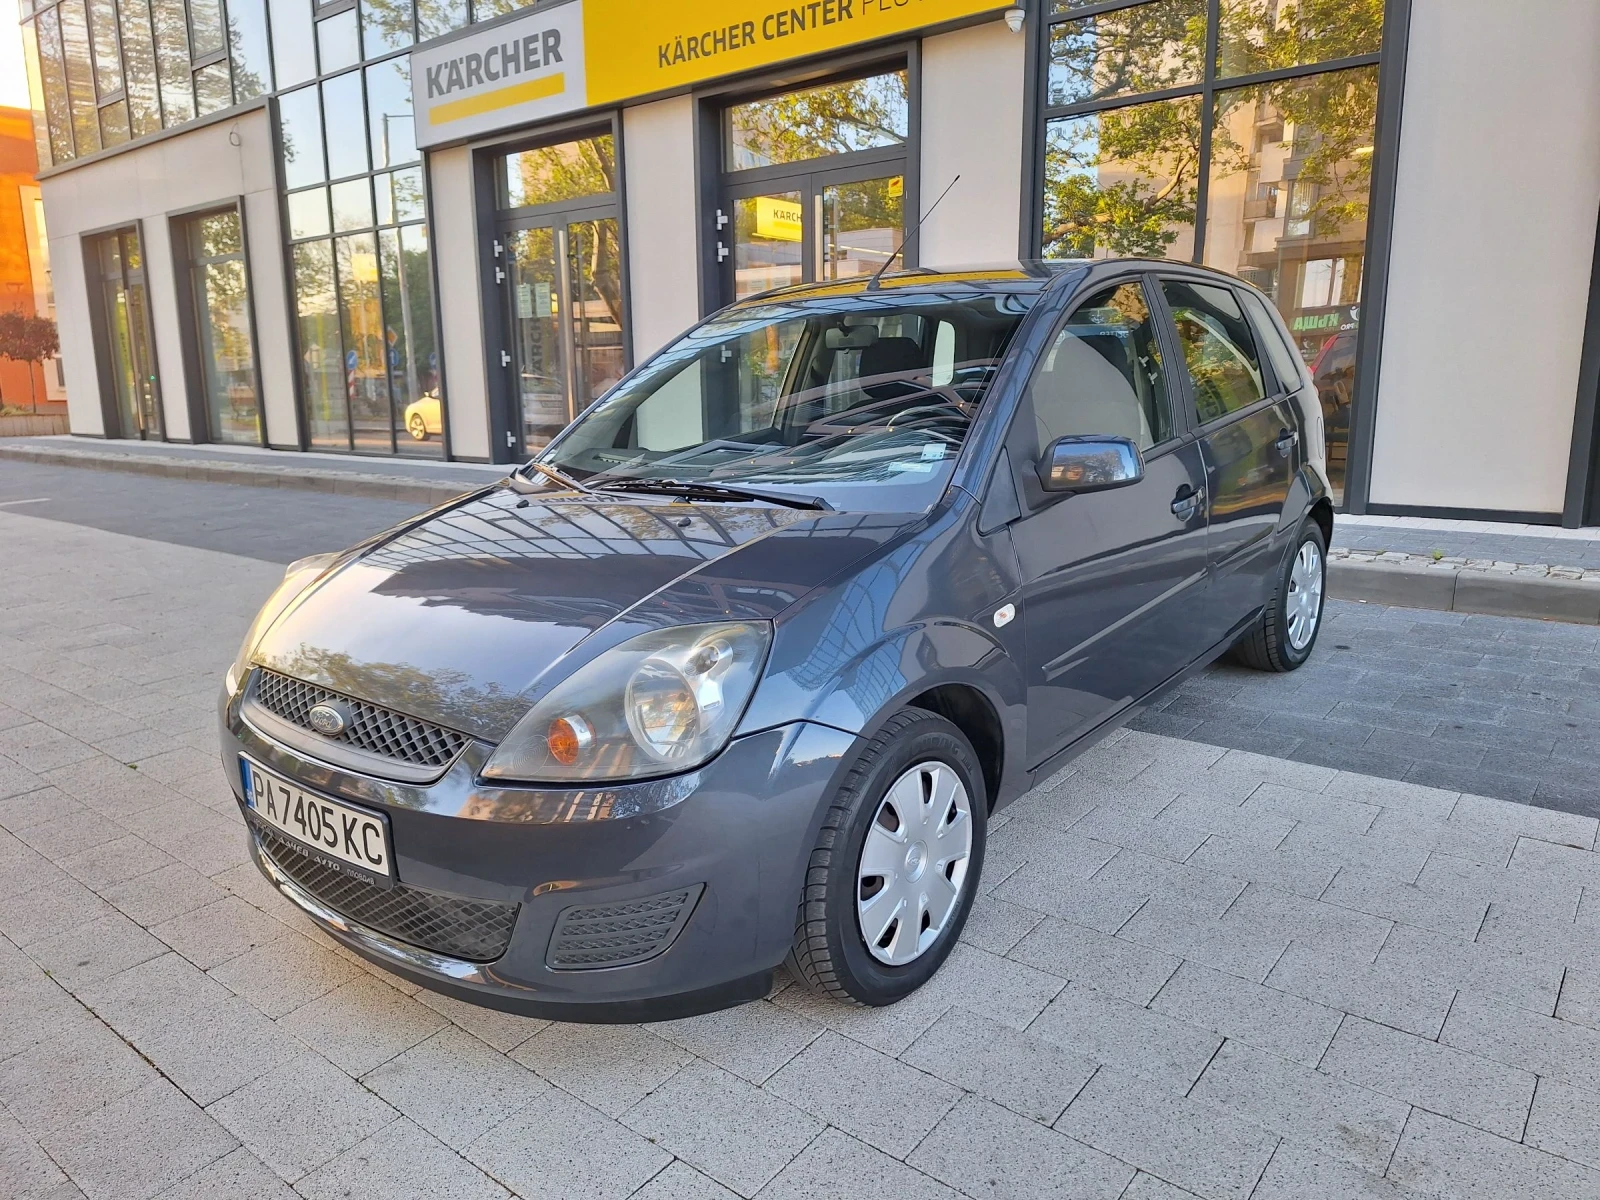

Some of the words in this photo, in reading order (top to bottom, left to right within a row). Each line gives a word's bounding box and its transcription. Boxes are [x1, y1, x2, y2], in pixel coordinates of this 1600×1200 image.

[426, 28, 564, 99] KÄRCHER
[658, 20, 756, 68] KÄRCHER
[762, 0, 853, 40] CENTER
